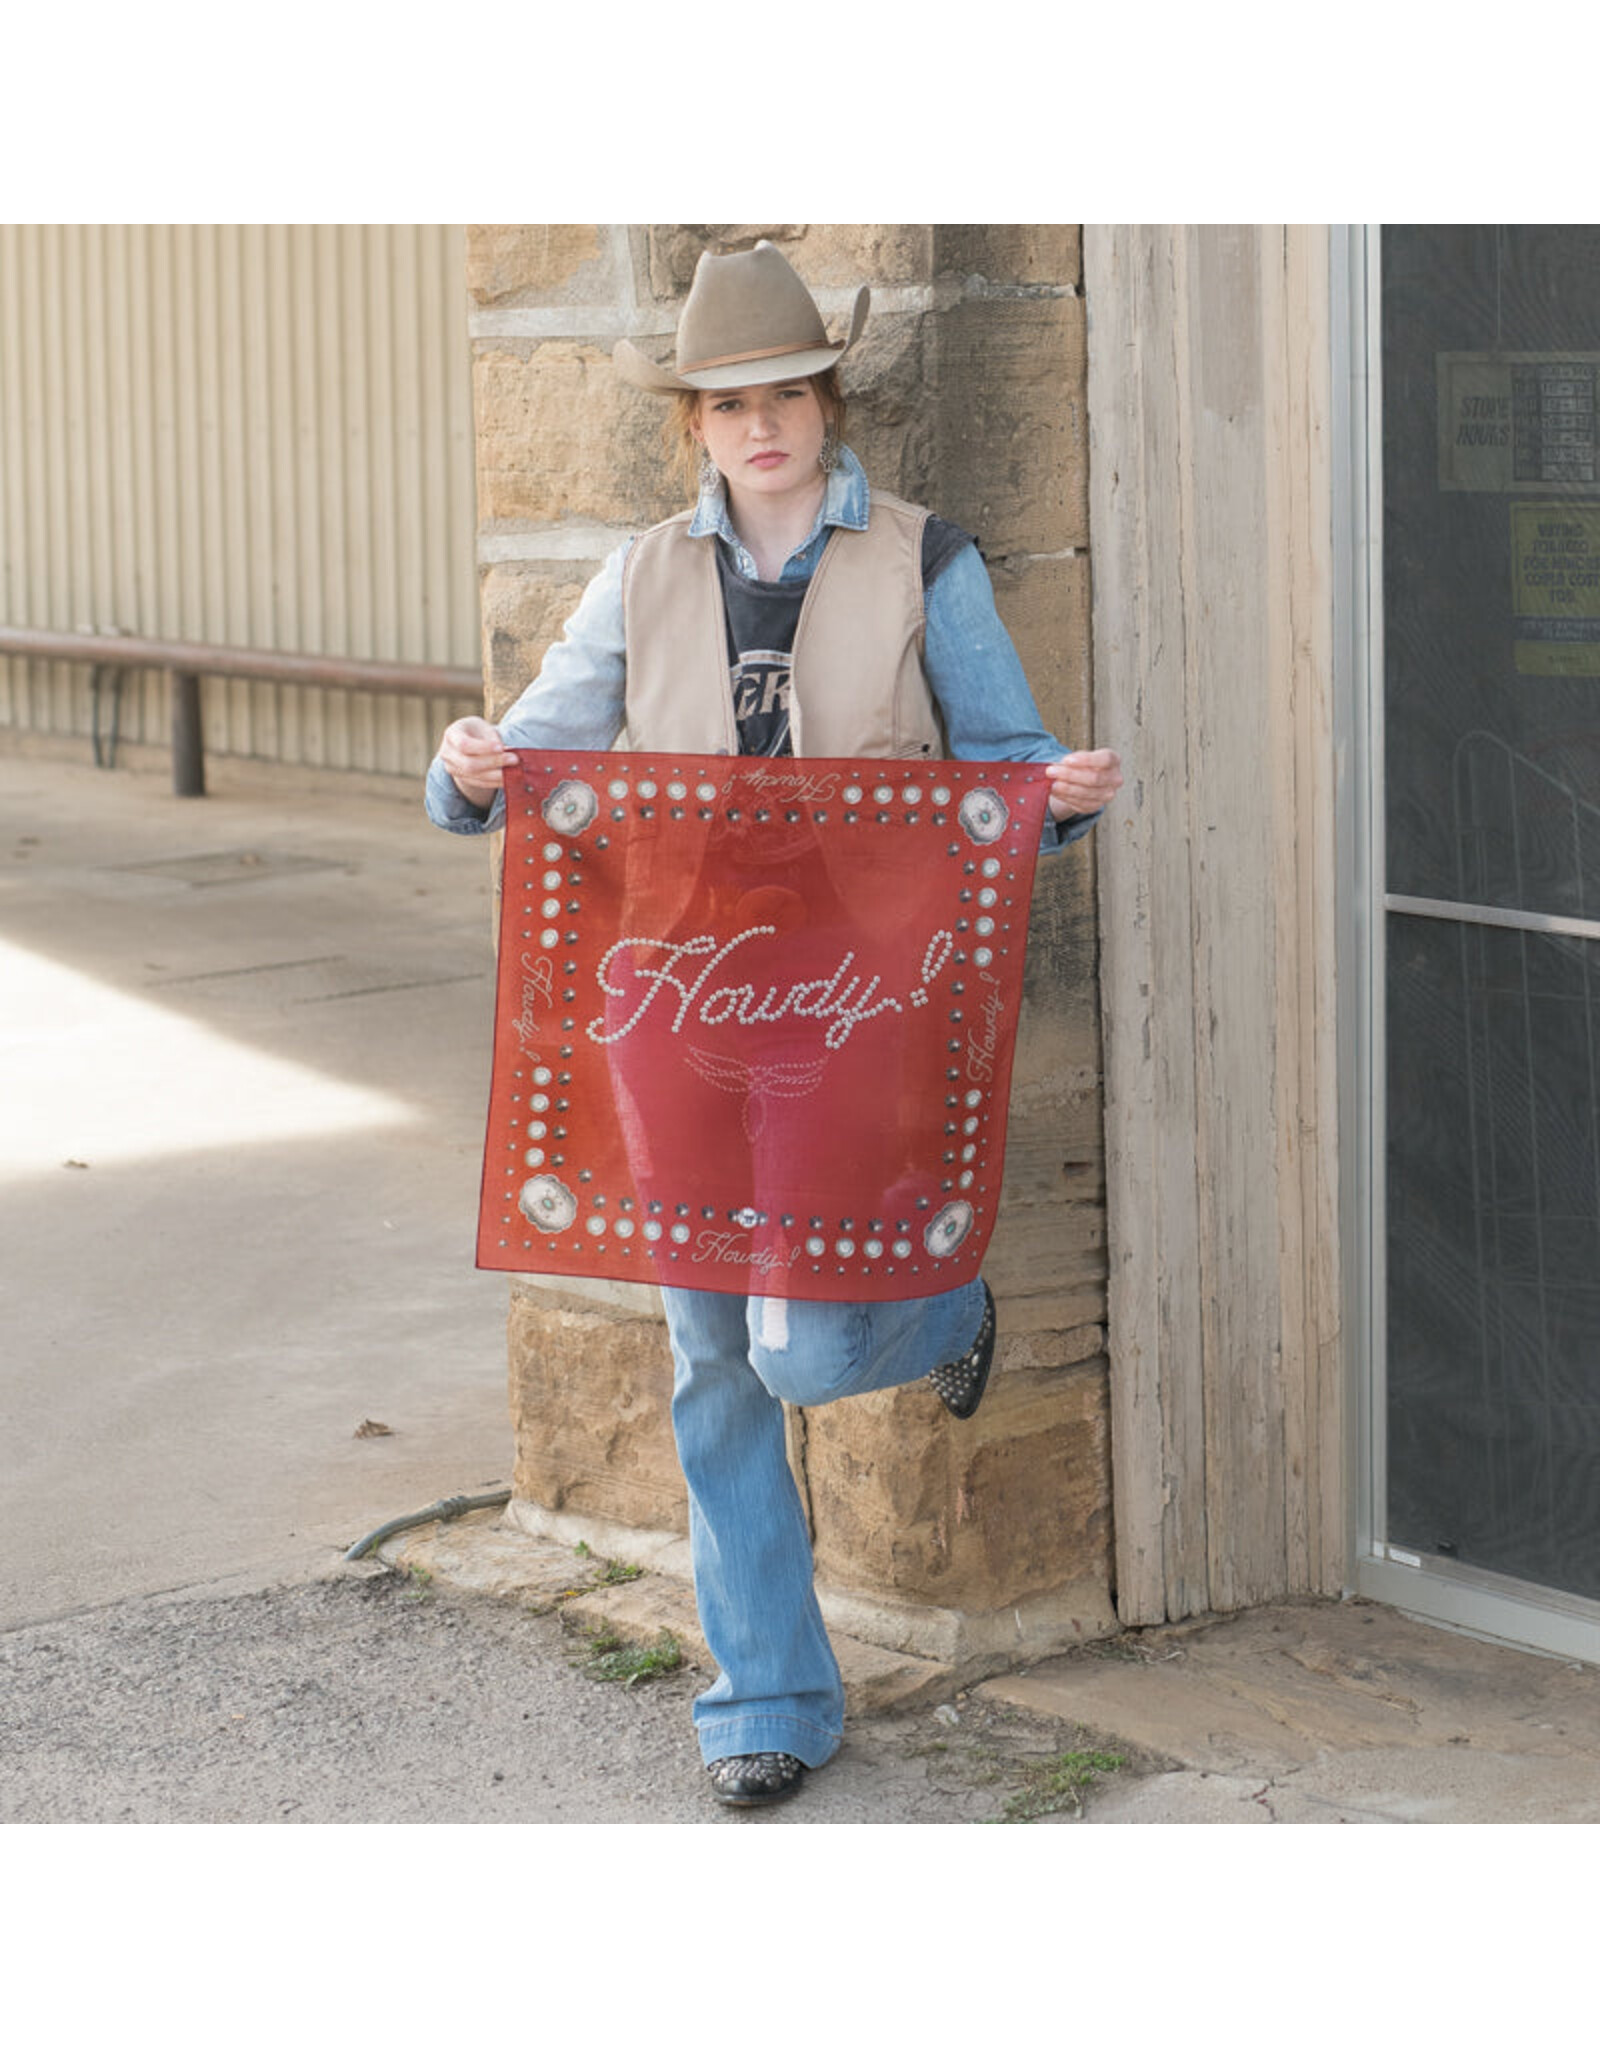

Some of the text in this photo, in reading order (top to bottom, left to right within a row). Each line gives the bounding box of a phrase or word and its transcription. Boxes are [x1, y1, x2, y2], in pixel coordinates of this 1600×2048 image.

[1460, 396, 1509, 418] STORE
[1456, 423, 1510, 446] HOURS
[586, 925, 953, 1050] Howdy!
